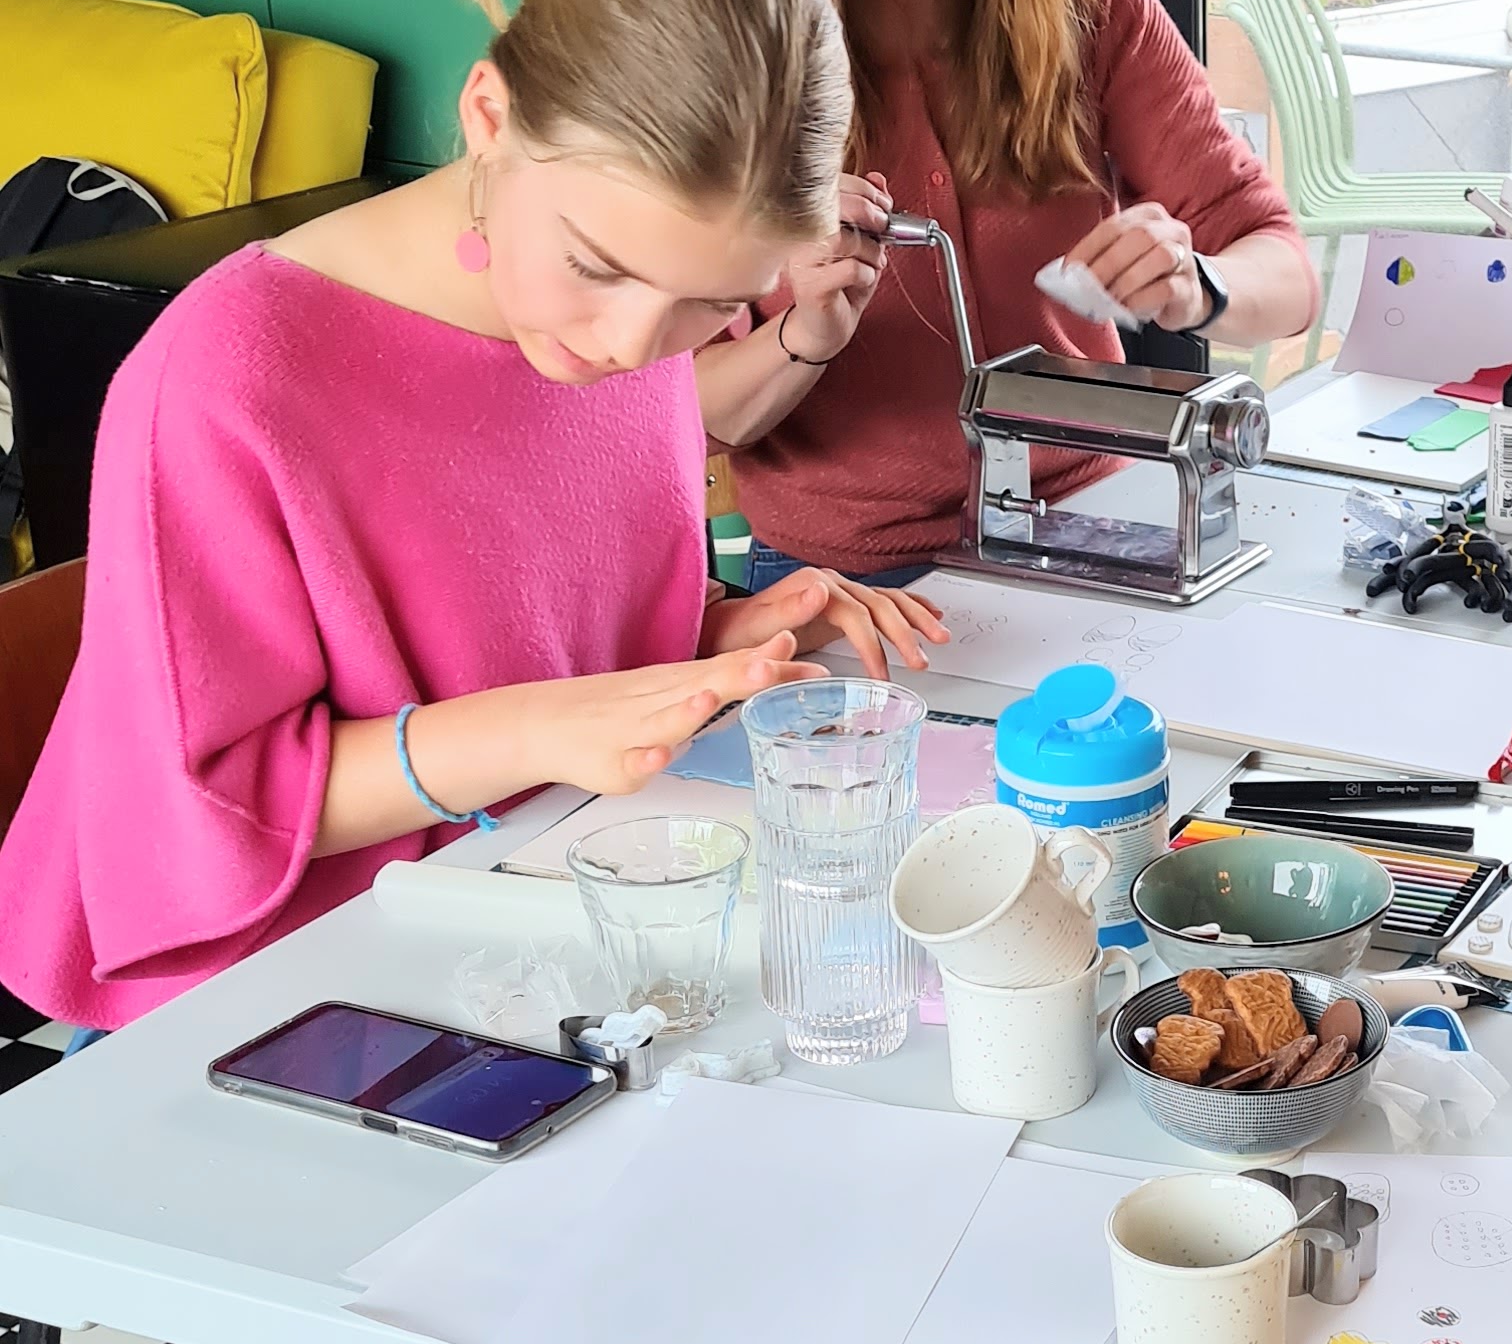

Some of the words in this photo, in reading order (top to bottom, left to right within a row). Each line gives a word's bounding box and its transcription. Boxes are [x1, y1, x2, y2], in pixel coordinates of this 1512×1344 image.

[1376, 785, 1405, 795] Drawing
[1405, 785, 1420, 793] Pen
[1016, 793, 1067, 816] Romed
